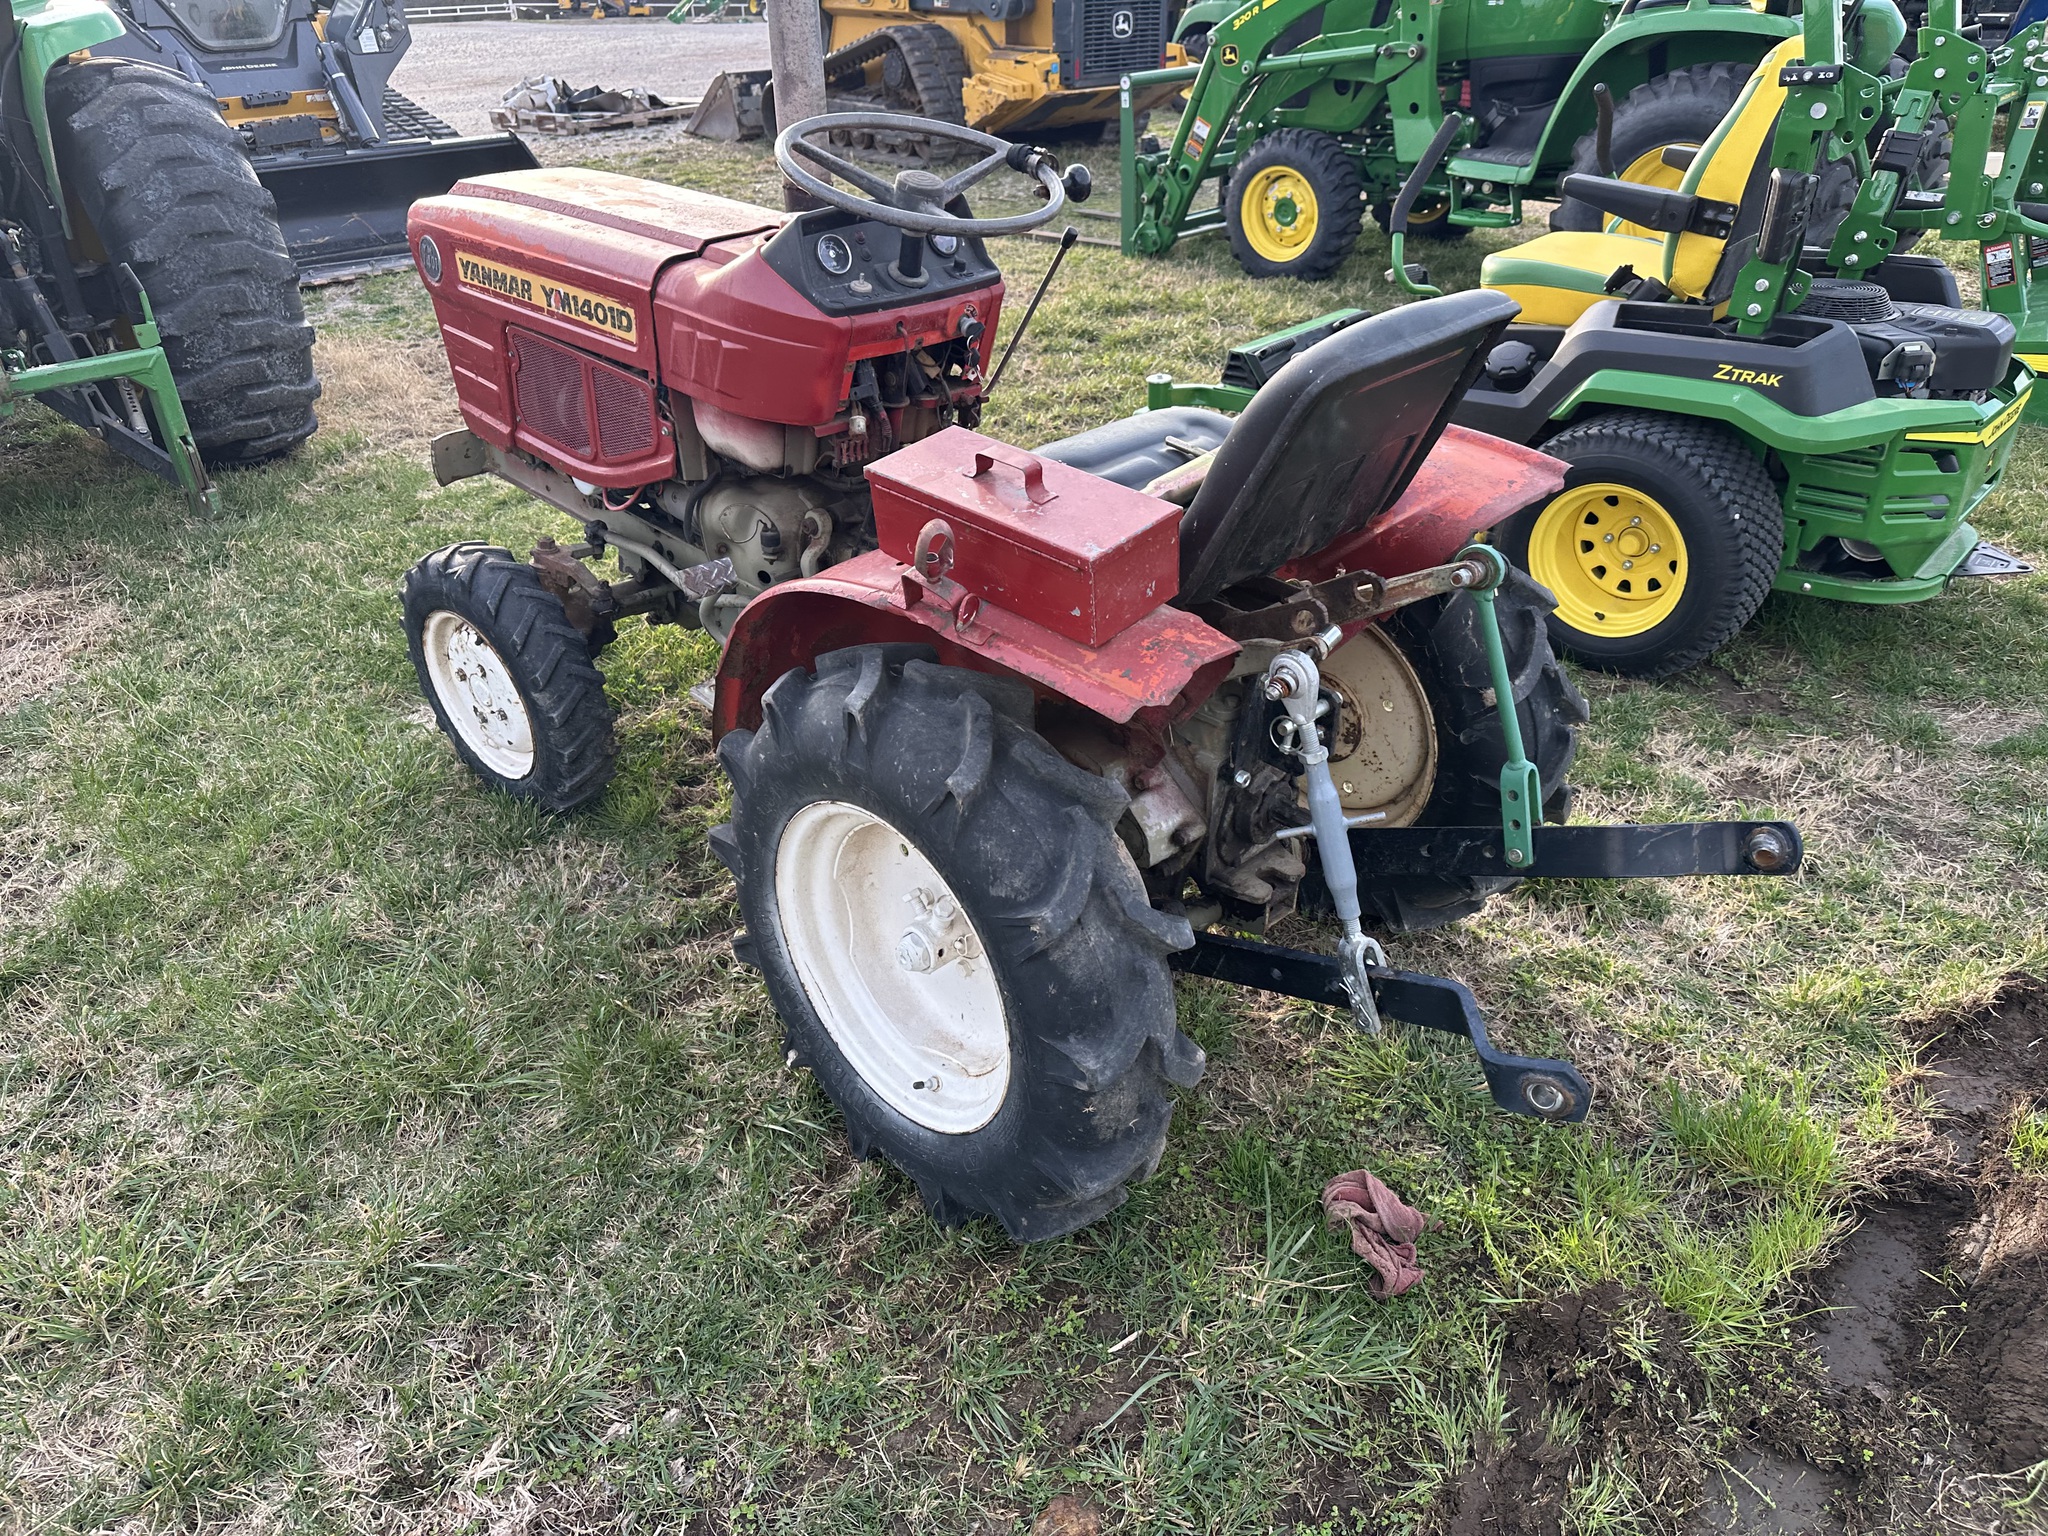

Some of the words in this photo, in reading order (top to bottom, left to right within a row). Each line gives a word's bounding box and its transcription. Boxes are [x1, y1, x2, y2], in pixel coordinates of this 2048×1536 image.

[1232, 10, 1252, 31] 320
[1252, 5, 1260, 16] R
[458, 257, 533, 301] YANMAR
[539, 283, 634, 334] YM1401D
[1712, 363, 1784, 388] ZTRAK
[1987, 420, 2004, 440] JOHN
[2003, 402, 2022, 426] DEERE
